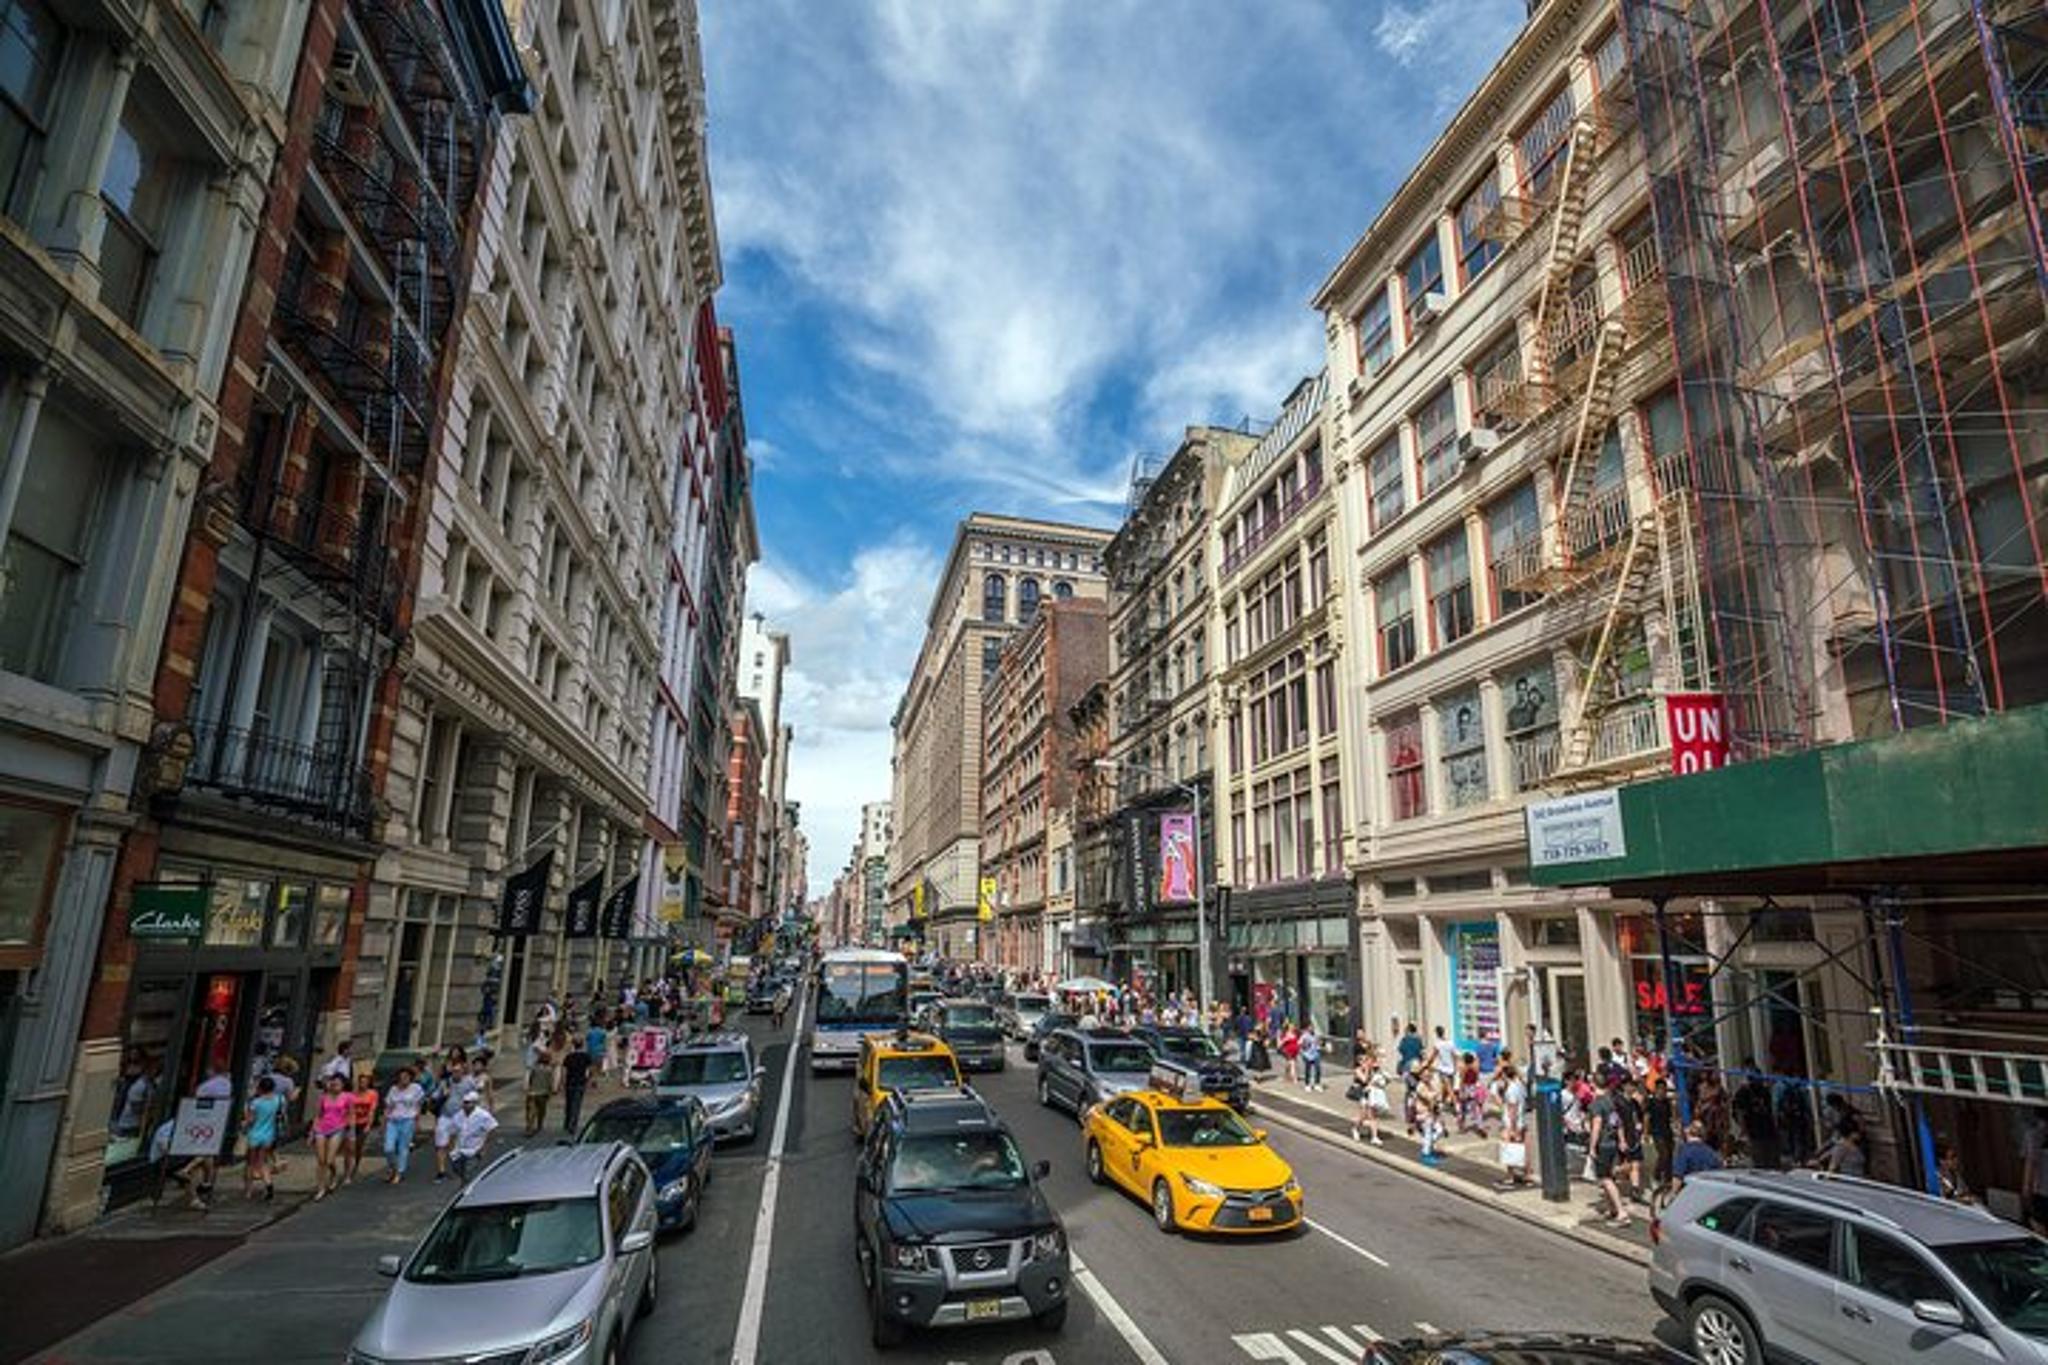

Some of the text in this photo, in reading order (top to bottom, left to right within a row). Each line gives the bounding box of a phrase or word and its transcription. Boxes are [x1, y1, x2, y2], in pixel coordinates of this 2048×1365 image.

[1134, 861, 1146, 912] REPUBLIC
[130, 910, 201, 930] Clarks
[1636, 980, 1705, 1014] SALE
